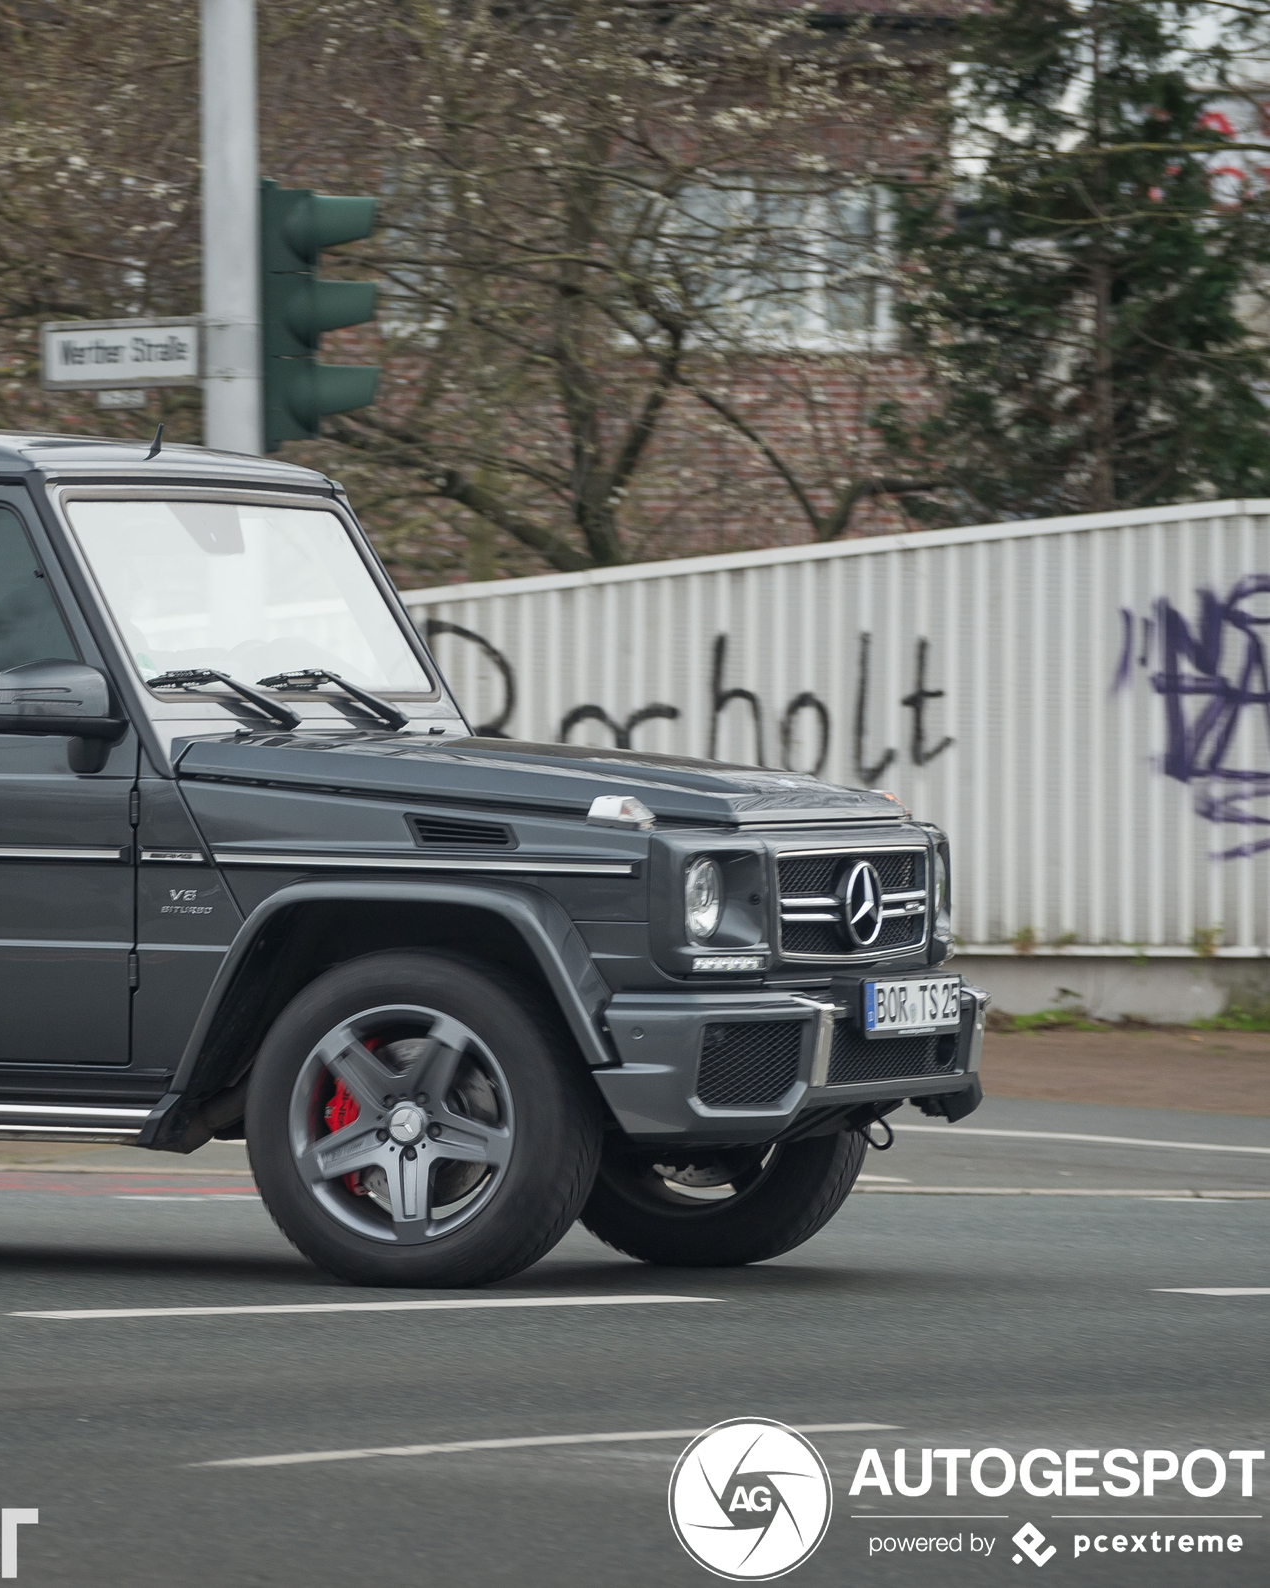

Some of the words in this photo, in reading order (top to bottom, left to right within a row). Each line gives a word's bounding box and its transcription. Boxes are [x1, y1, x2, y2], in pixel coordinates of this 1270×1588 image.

[169, 889, 197, 901] V8
[160, 905, 213, 914] BITURBO
[876, 985, 909, 1024] BOR
[918, 983, 938, 1021] TS
[941, 982, 959, 1019] 25
